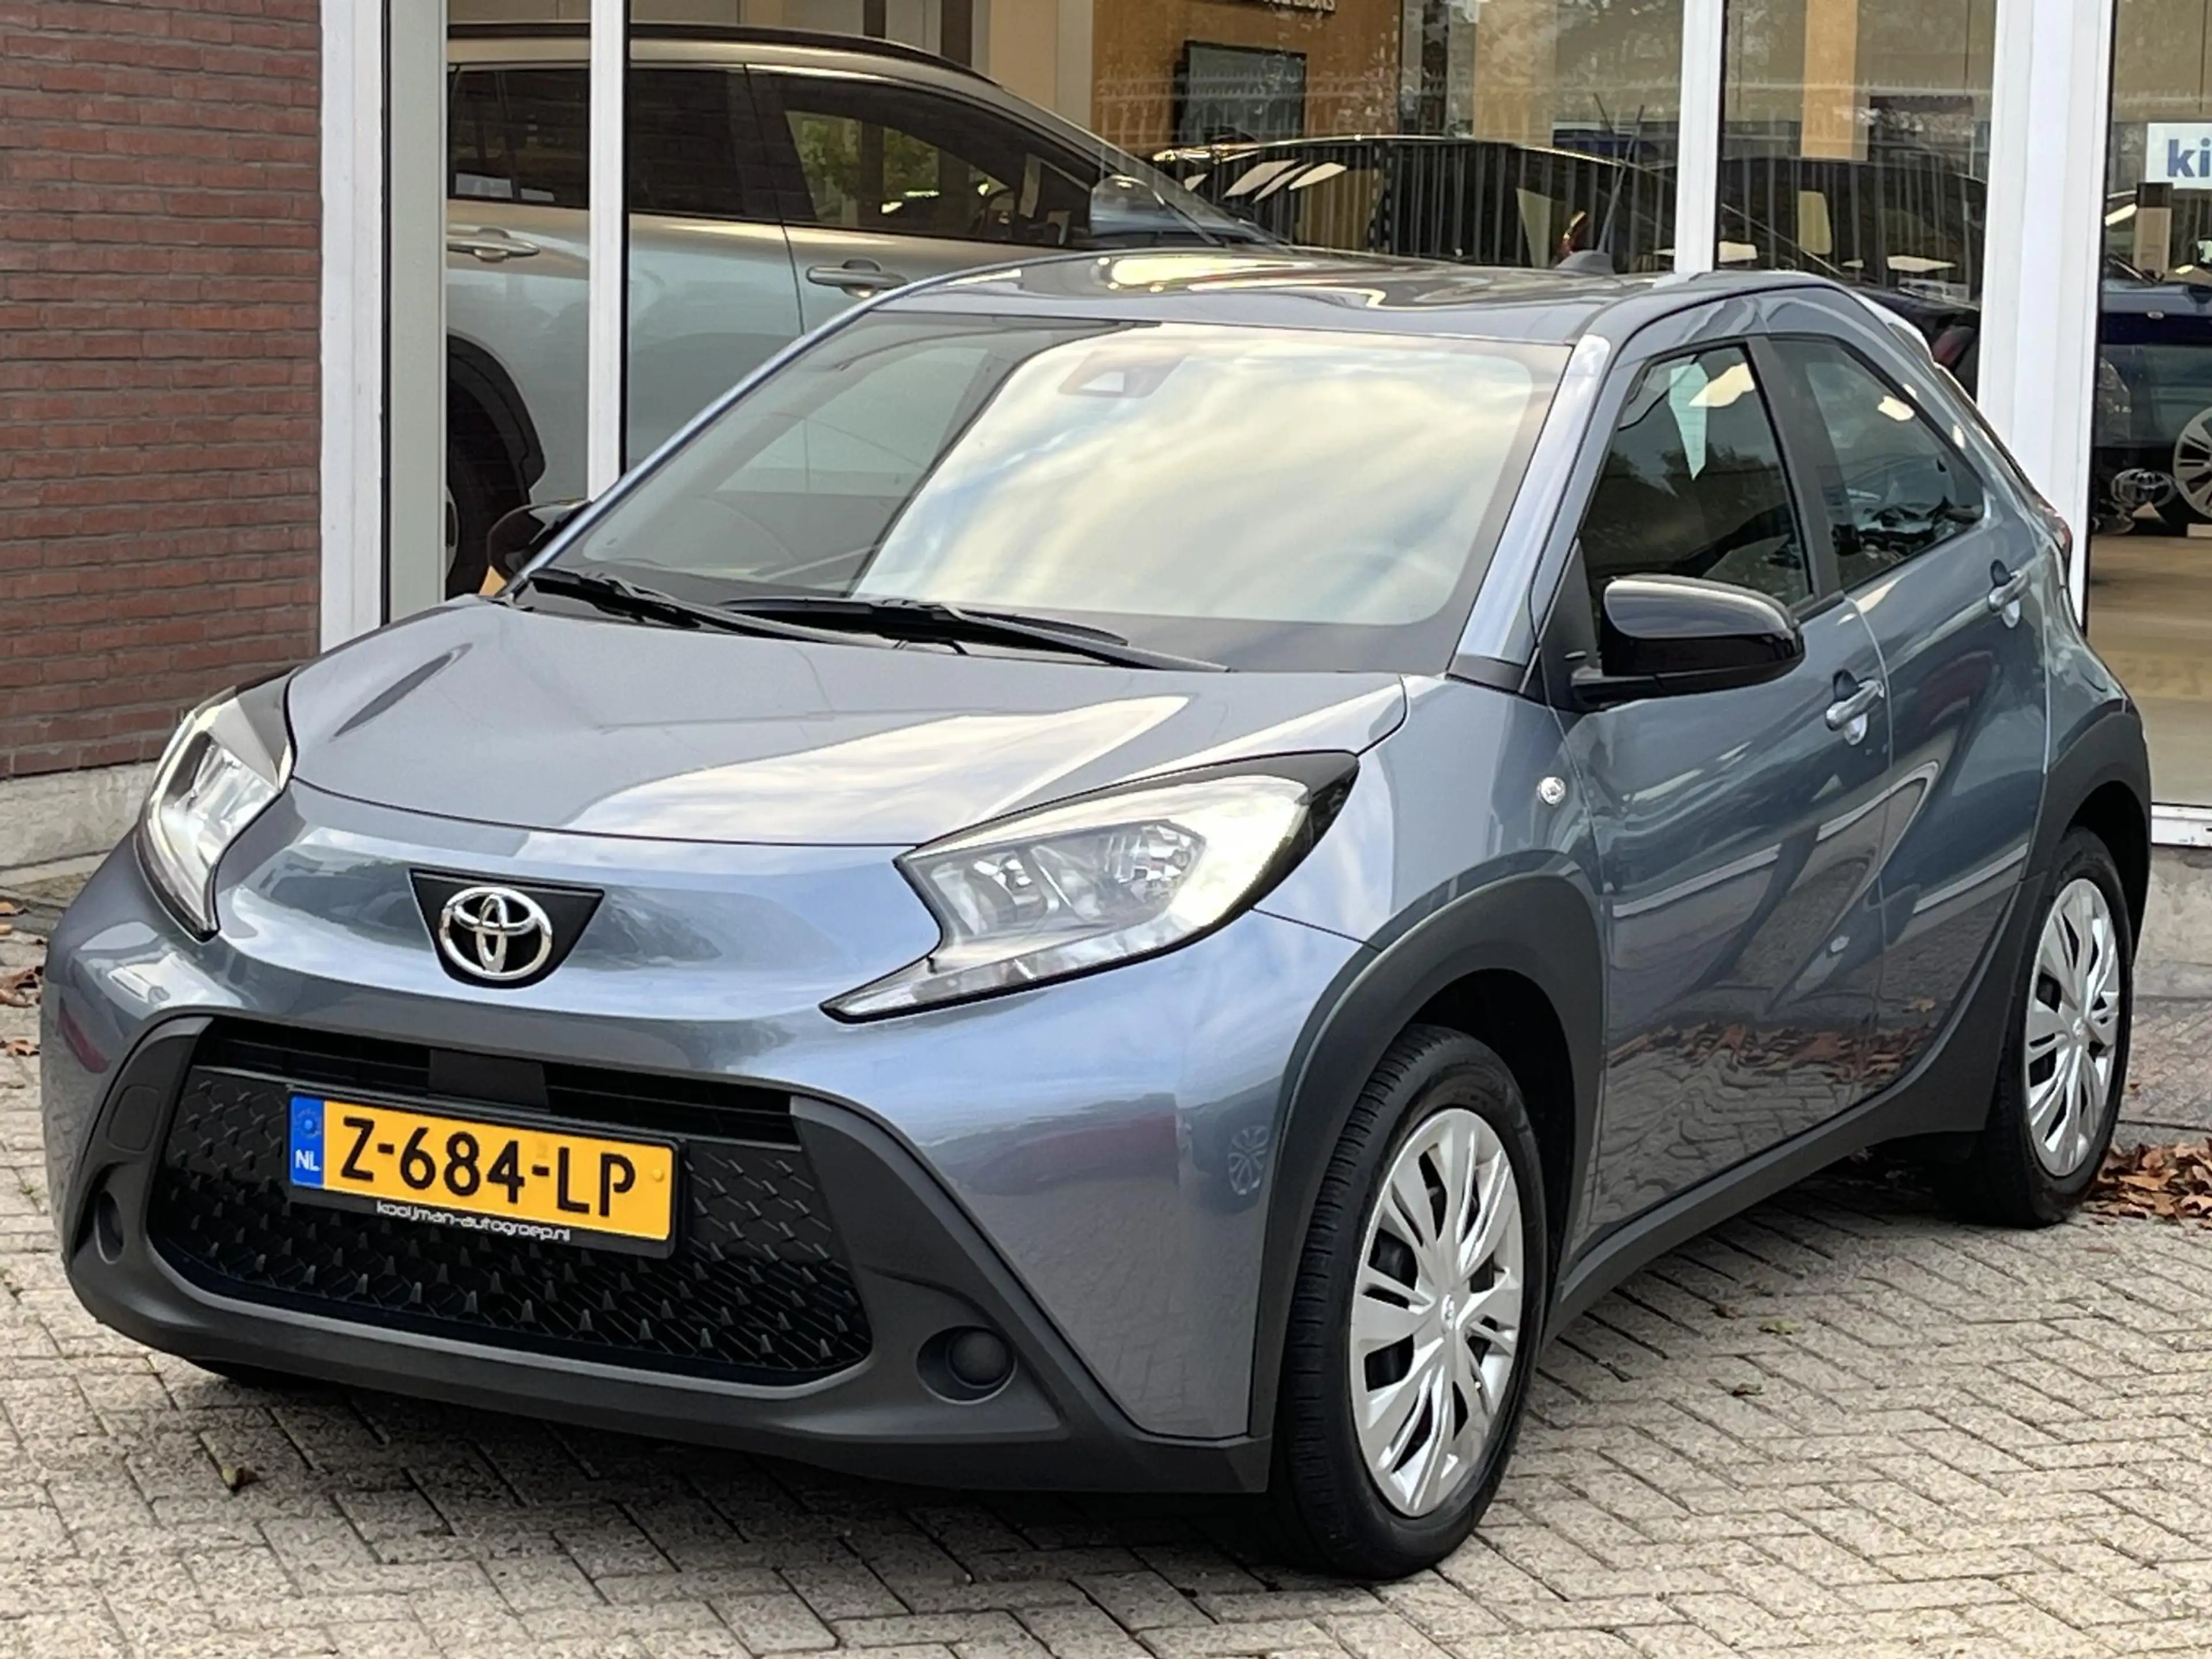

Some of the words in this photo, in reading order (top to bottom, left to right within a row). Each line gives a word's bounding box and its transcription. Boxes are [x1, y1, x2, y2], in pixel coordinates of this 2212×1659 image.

[295, 1149, 321, 1172] NL
[340, 1115, 635, 1217] Z-684-LP
[376, 1200, 571, 1242] kooijman-autogroep.nl
